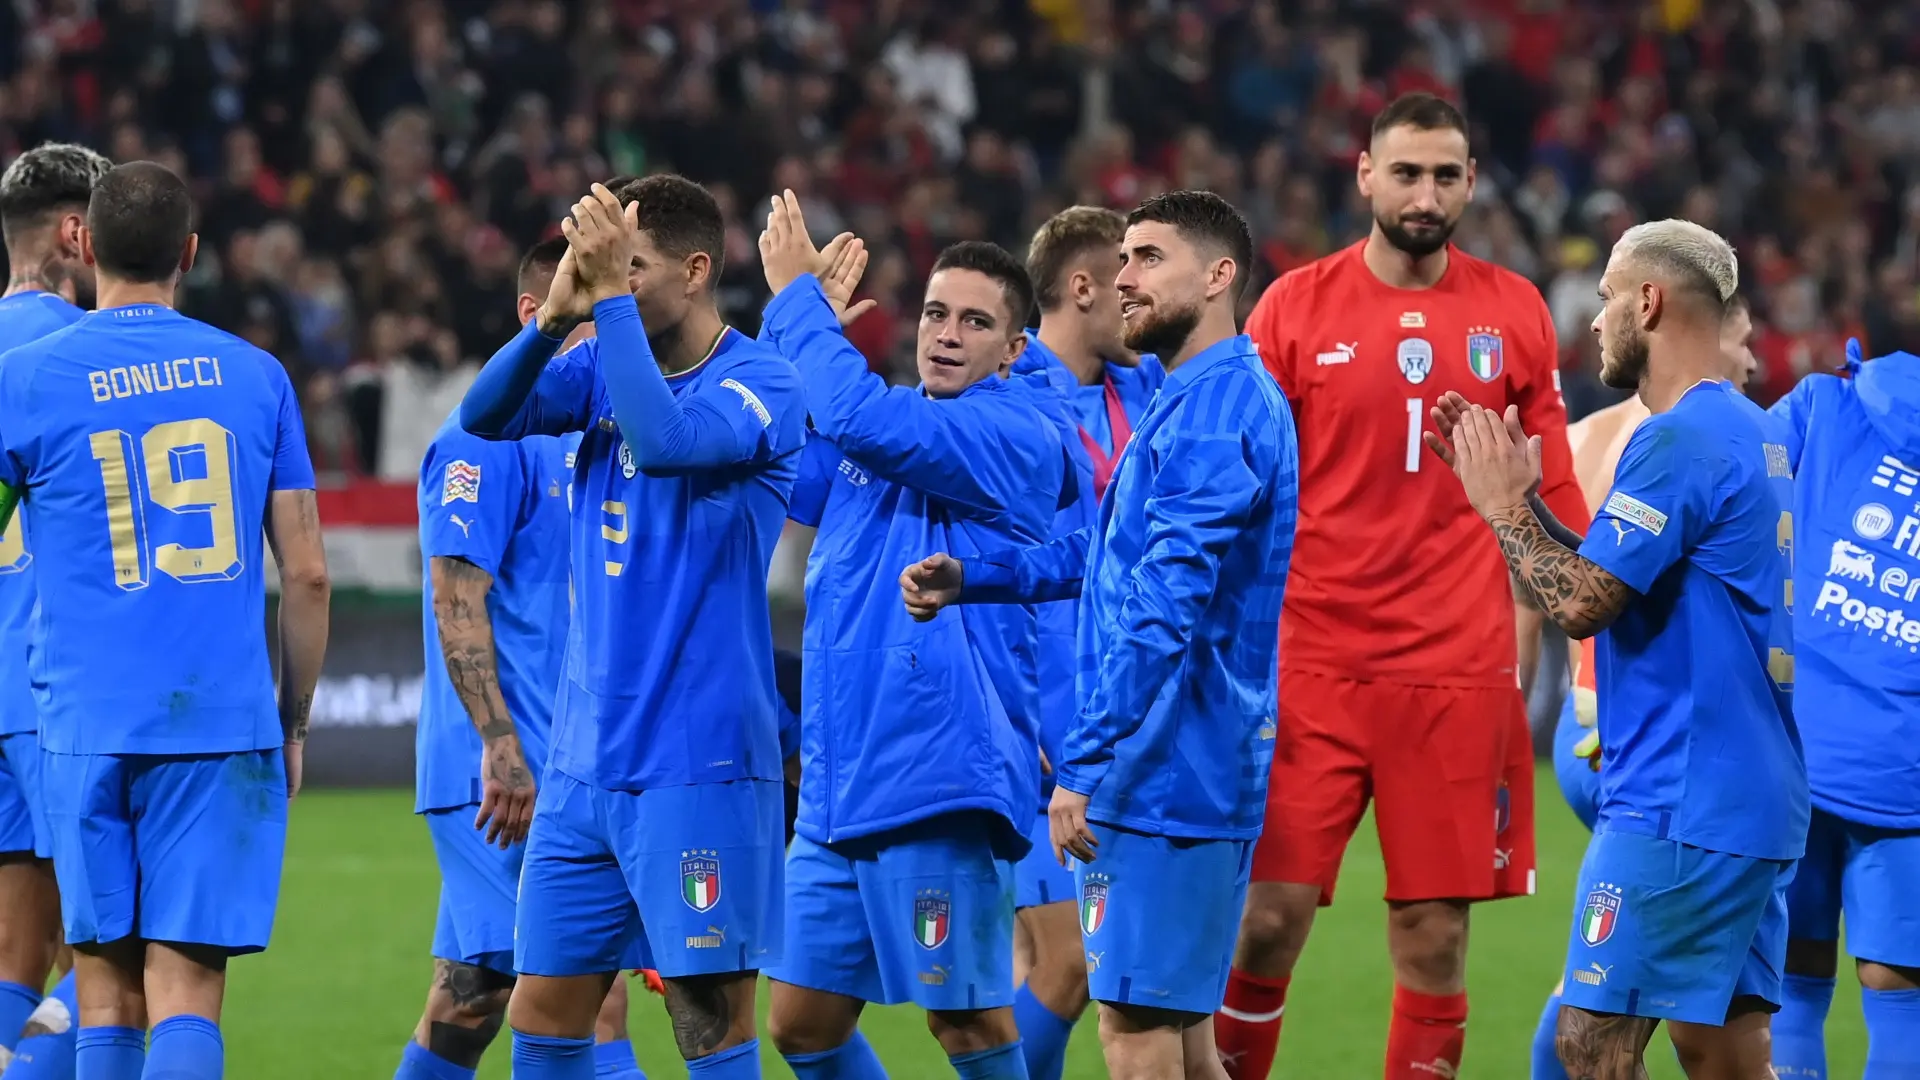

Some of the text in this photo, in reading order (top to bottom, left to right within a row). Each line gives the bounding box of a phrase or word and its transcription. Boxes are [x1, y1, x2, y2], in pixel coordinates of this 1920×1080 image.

[1316, 352, 1350, 366] PUMA
[88, 356, 223, 402] BONUCCI
[1406, 398, 1423, 473] 1
[88, 417, 244, 591] 19
[1610, 497, 1664, 530] FOUNDATION
[1862, 512, 1884, 530] FIAT
[1815, 580, 1920, 644] Poste
[684, 862, 716, 872] ITALIA
[1085, 886, 1106, 896] ITALIA
[917, 901, 948, 911] ITALIA
[1589, 896, 1616, 907] ITALIA
[686, 936, 720, 949] PUMA
